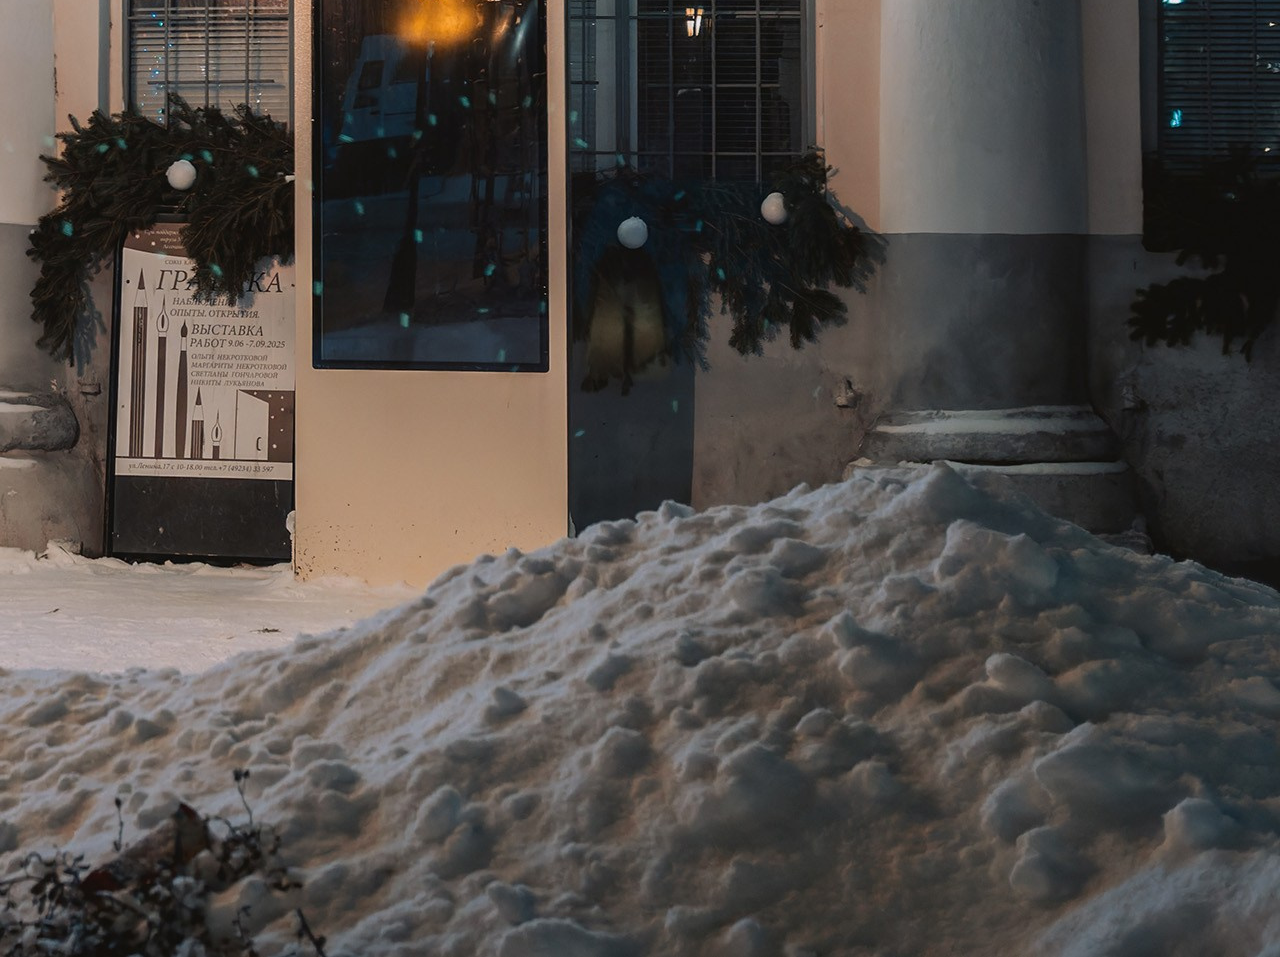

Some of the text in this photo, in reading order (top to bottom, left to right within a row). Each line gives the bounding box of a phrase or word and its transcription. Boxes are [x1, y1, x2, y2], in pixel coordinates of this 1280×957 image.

[156, 269, 283, 293] ГРАКА
[191, 324, 264, 337] ВЫСТАВКА
[190, 338, 227, 348] РАБОТ
[227, 339, 245, 348] 9.06
